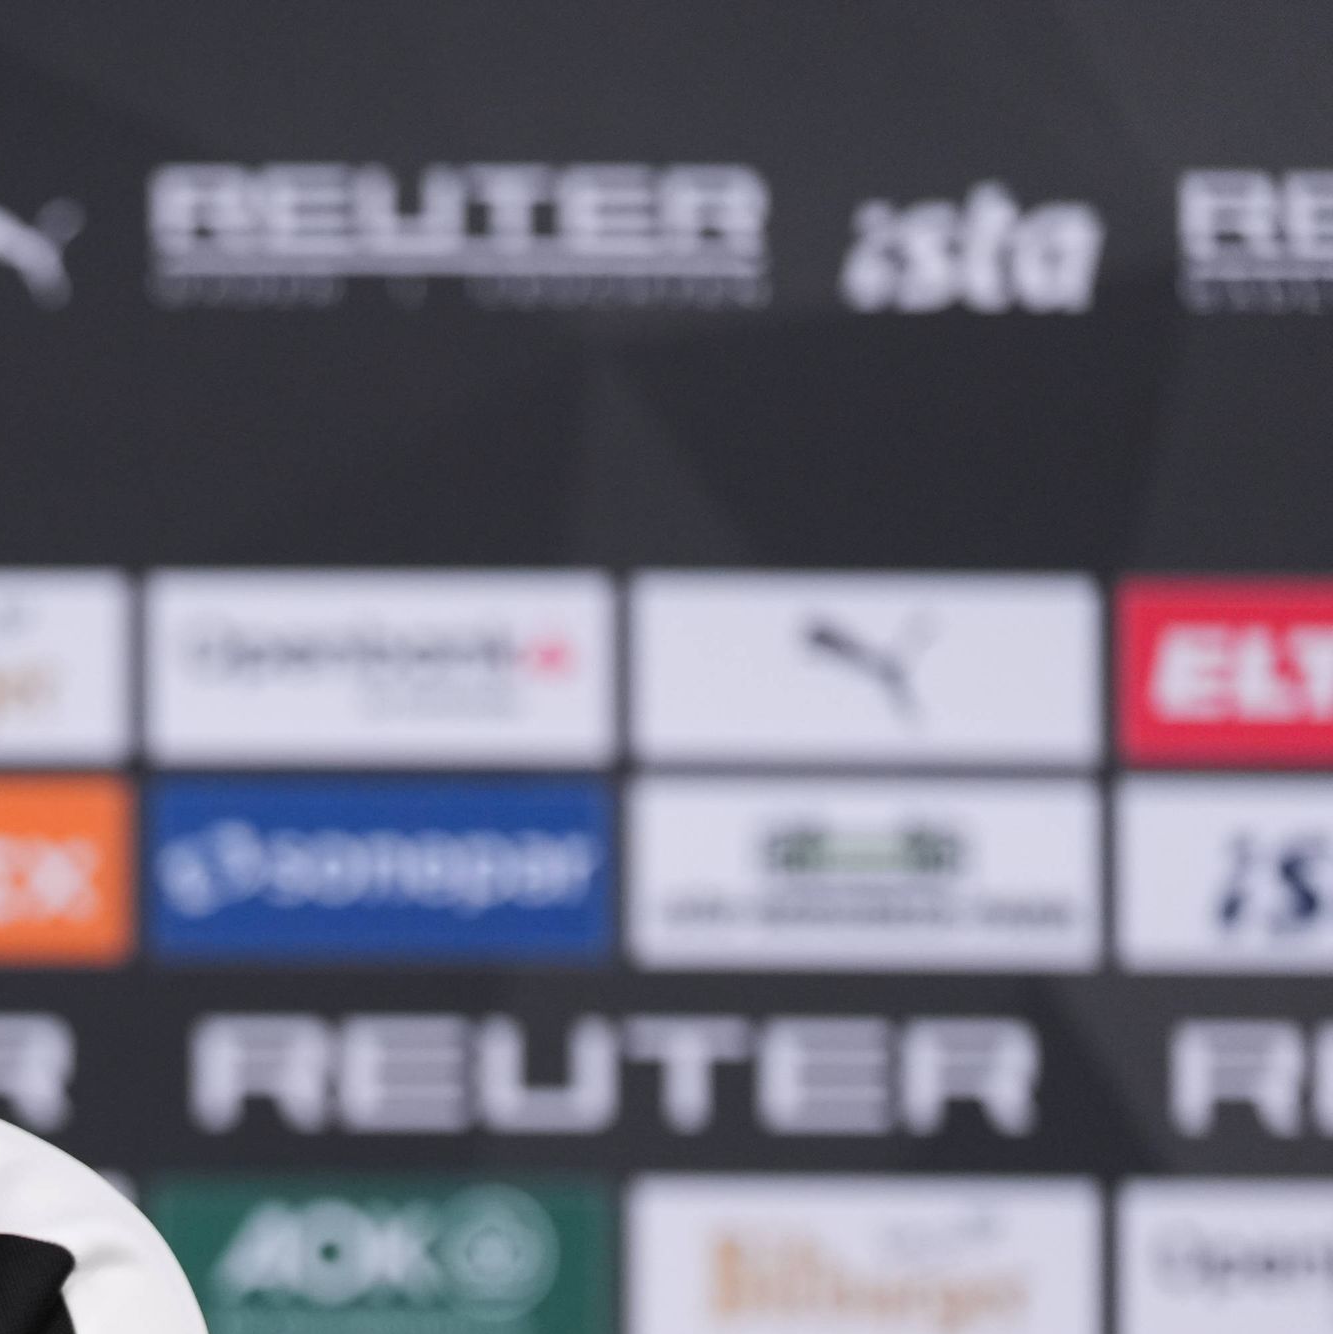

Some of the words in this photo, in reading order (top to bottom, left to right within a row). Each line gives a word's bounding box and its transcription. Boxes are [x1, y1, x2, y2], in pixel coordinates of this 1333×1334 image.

[146, 162, 771, 259] REUTER
[840, 177, 1106, 315] ista
[1147, 620, 1333, 725] ELT
[263, 828, 599, 920] sonepar
[1213, 834, 1333, 938] is
[187, 1012, 1043, 1136] REUTER
[206, 1199, 445, 1312] AOK
